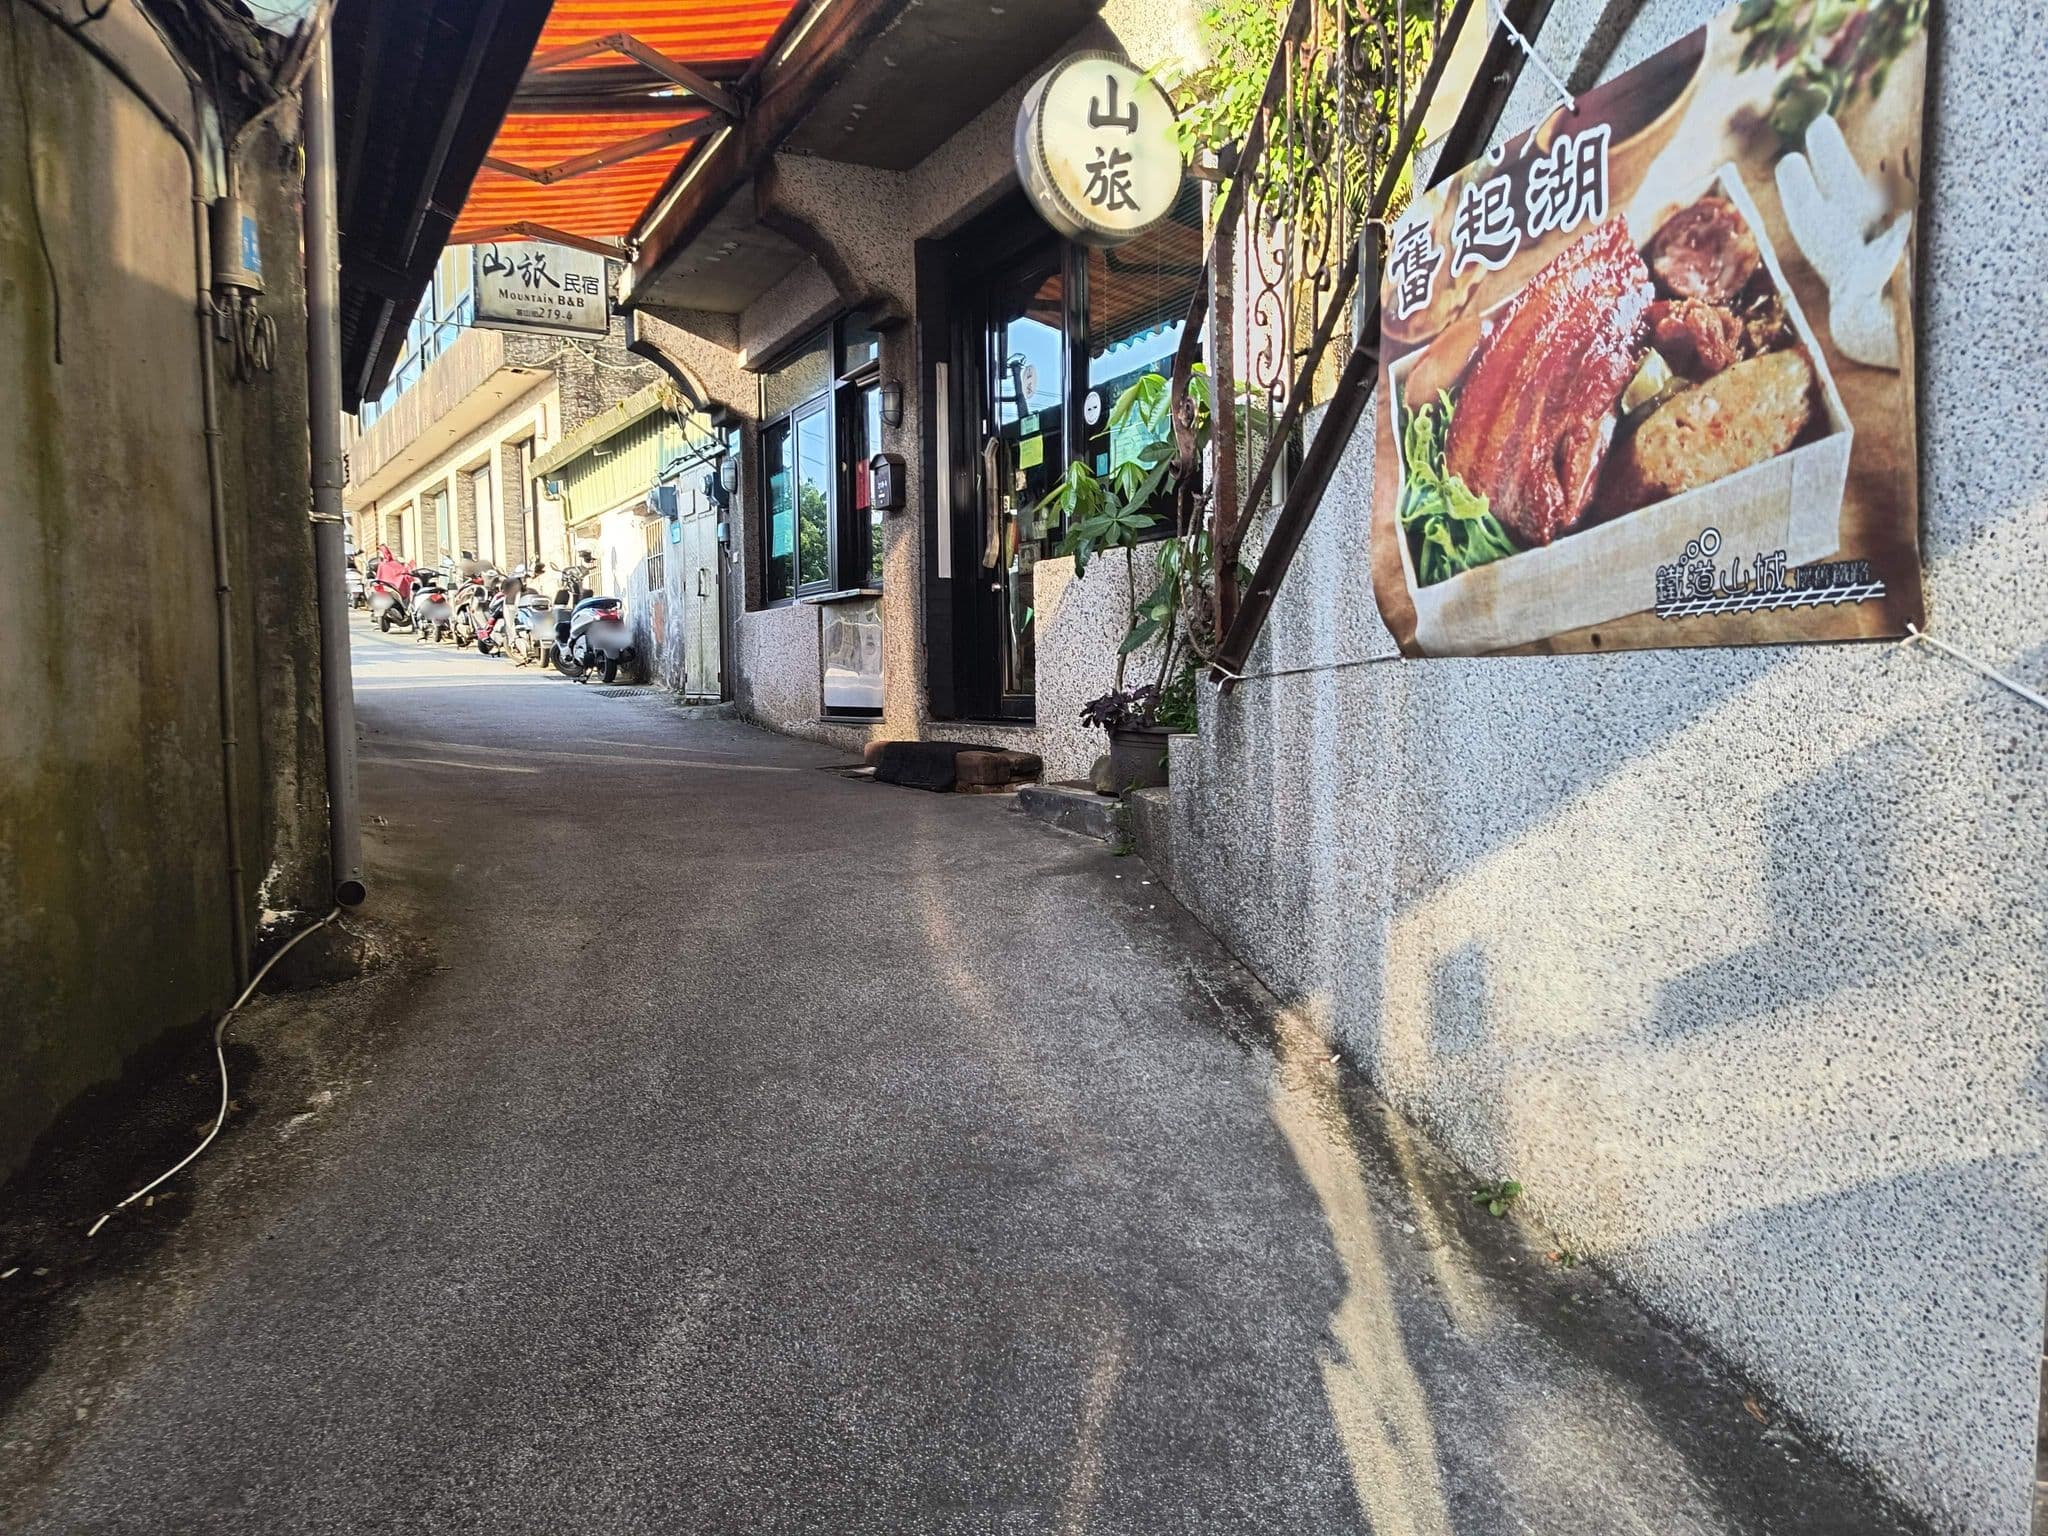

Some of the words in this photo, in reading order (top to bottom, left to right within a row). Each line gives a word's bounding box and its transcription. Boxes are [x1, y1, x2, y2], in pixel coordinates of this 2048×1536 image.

[1083, 74, 1141, 212] 山旅
[1388, 124, 1611, 320] 奮起湖
[558, 295, 585, 308] B&B
[564, 273, 599, 295] 民宿
[1655, 551, 1787, 601] 鐵道山城
